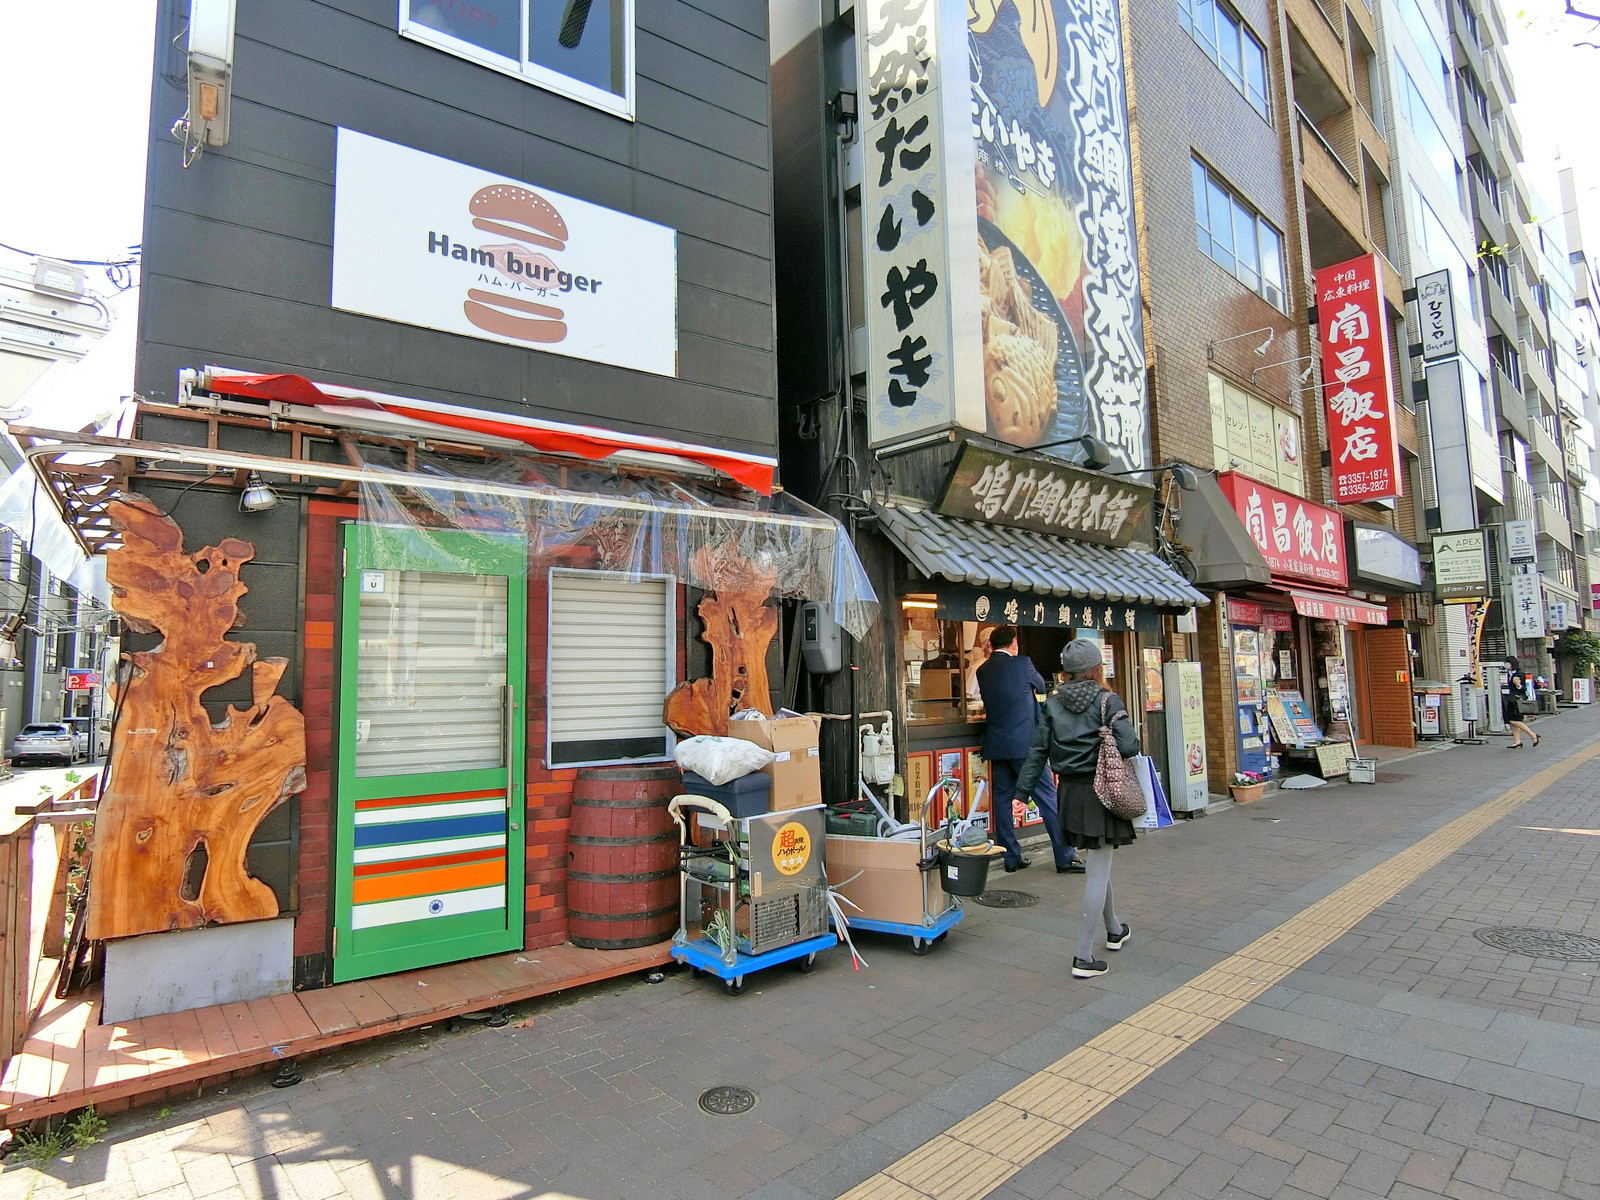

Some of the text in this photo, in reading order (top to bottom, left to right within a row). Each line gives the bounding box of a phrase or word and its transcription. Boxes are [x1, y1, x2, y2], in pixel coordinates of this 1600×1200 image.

[427, 230, 603, 295] Ham burger
[477, 272, 560, 298] ハム・バーガー
[1333, 269, 1356, 284] 中国
[1322, 279, 1370, 302] 広東料理
[1427, 300, 1445, 340] ひつじや
[1328, 302, 1385, 464] 南昌飯店
[1347, 468, 1388, 484] 3357-1874
[1348, 480, 1389, 496] 3356-2827
[1245, 486, 1338, 565] 南昌飯店
[1456, 537, 1481, 547] APEX
